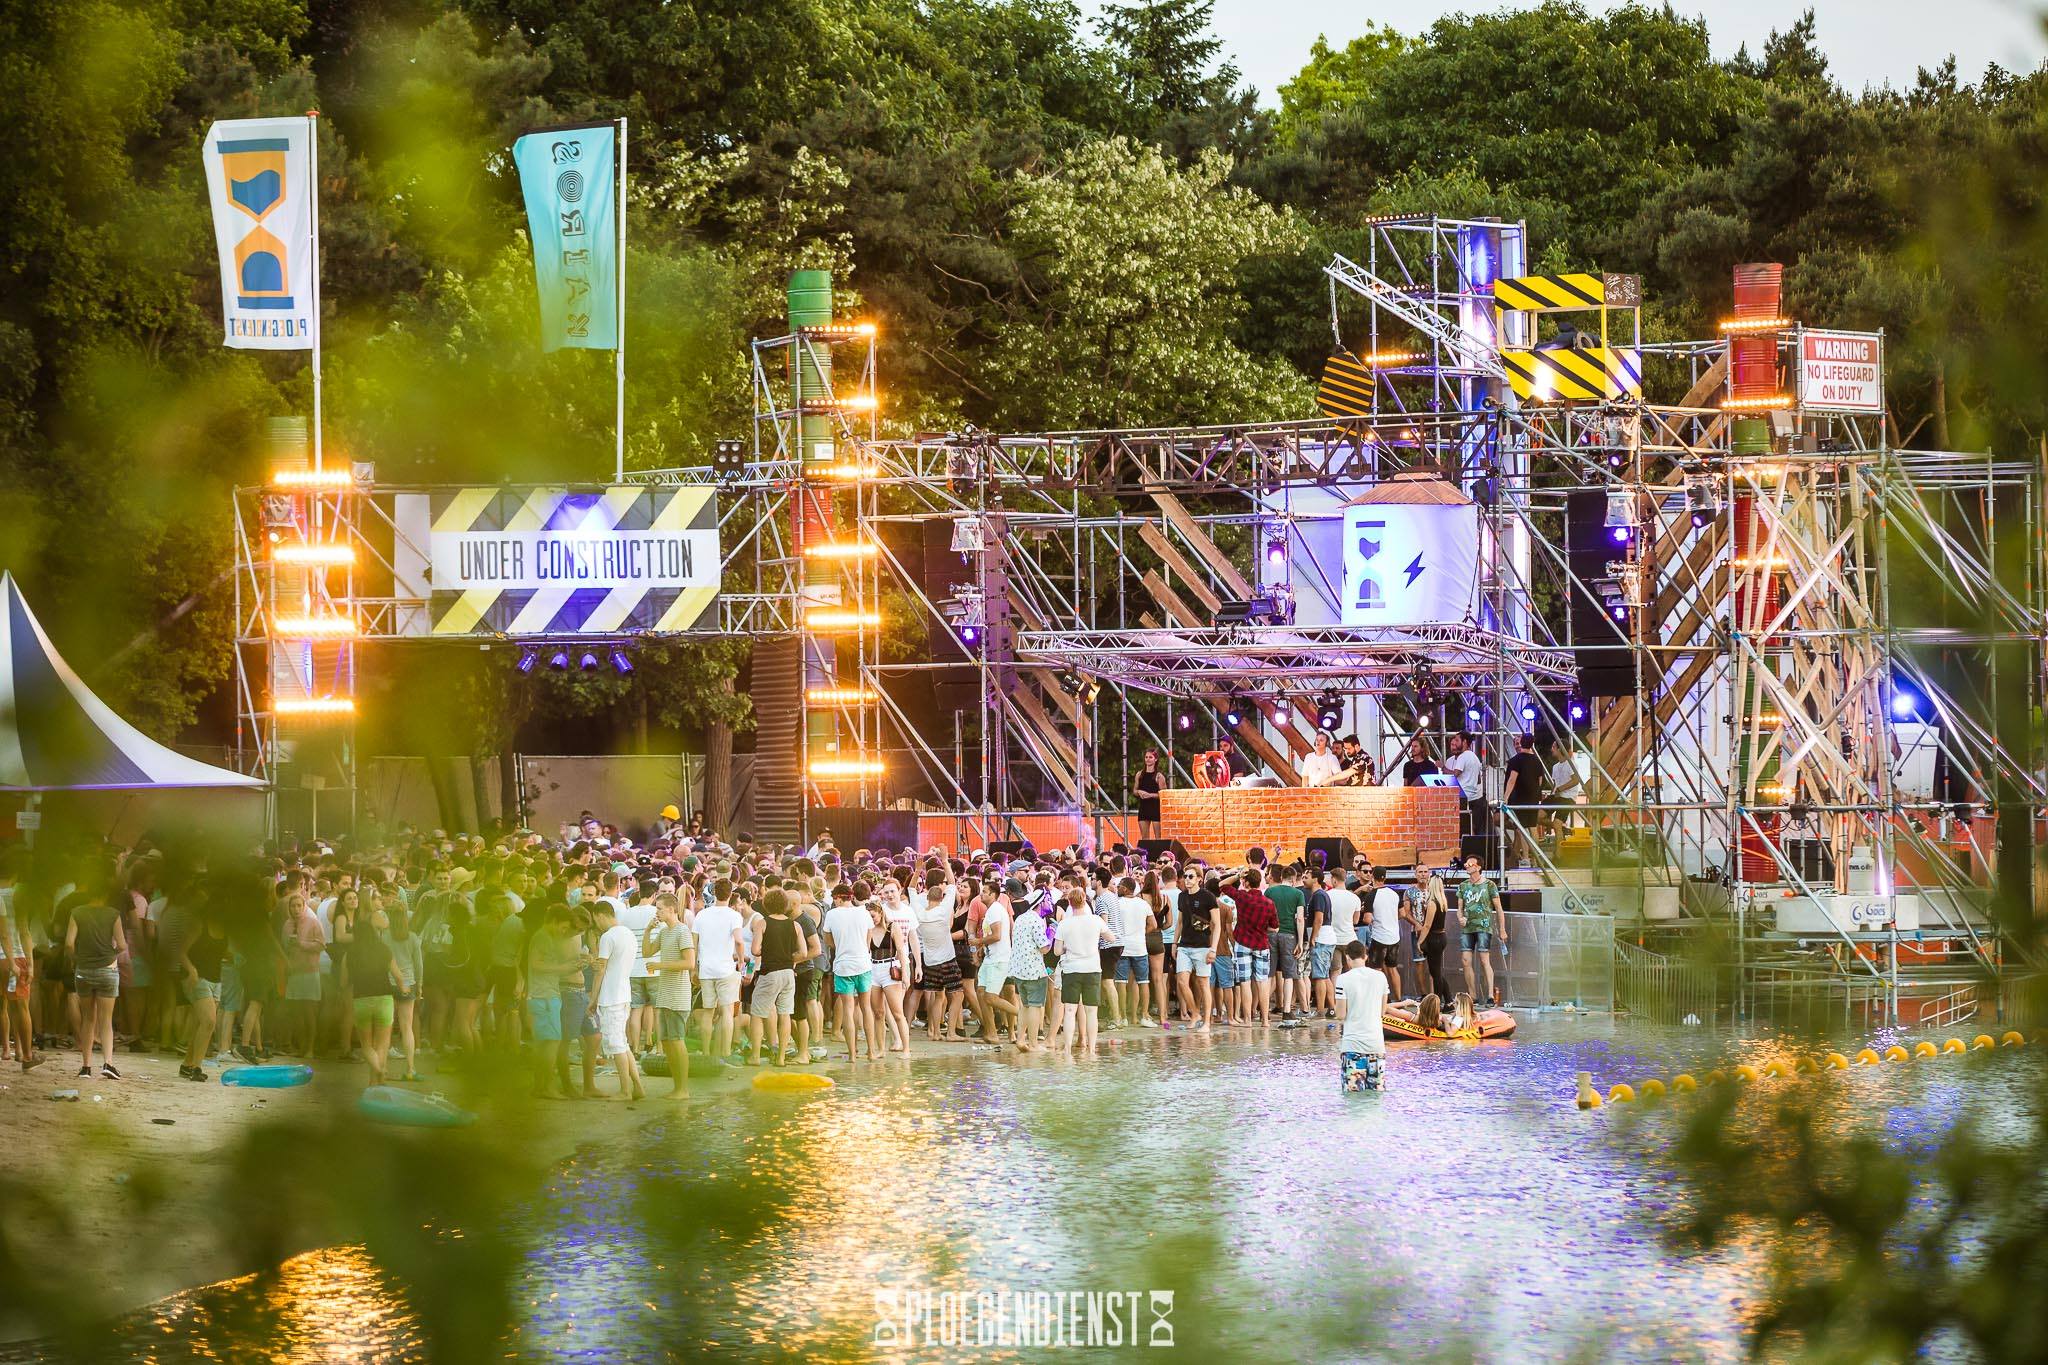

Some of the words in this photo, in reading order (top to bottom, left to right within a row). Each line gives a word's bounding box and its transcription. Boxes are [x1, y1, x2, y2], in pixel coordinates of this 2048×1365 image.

[1814, 339, 1869, 361] WARNING
[1807, 364, 1821, 380] NO
[1823, 365, 1874, 383] LIFEGUARD
[1822, 384, 1836, 400] ON
[1838, 385, 1863, 401] DUTY
[459, 540, 524, 580] UNDER
[536, 538, 694, 580] CONSTRUCTION
[1381, 1015, 1407, 1028] LORER
[1407, 1024, 1423, 1033] PRO
